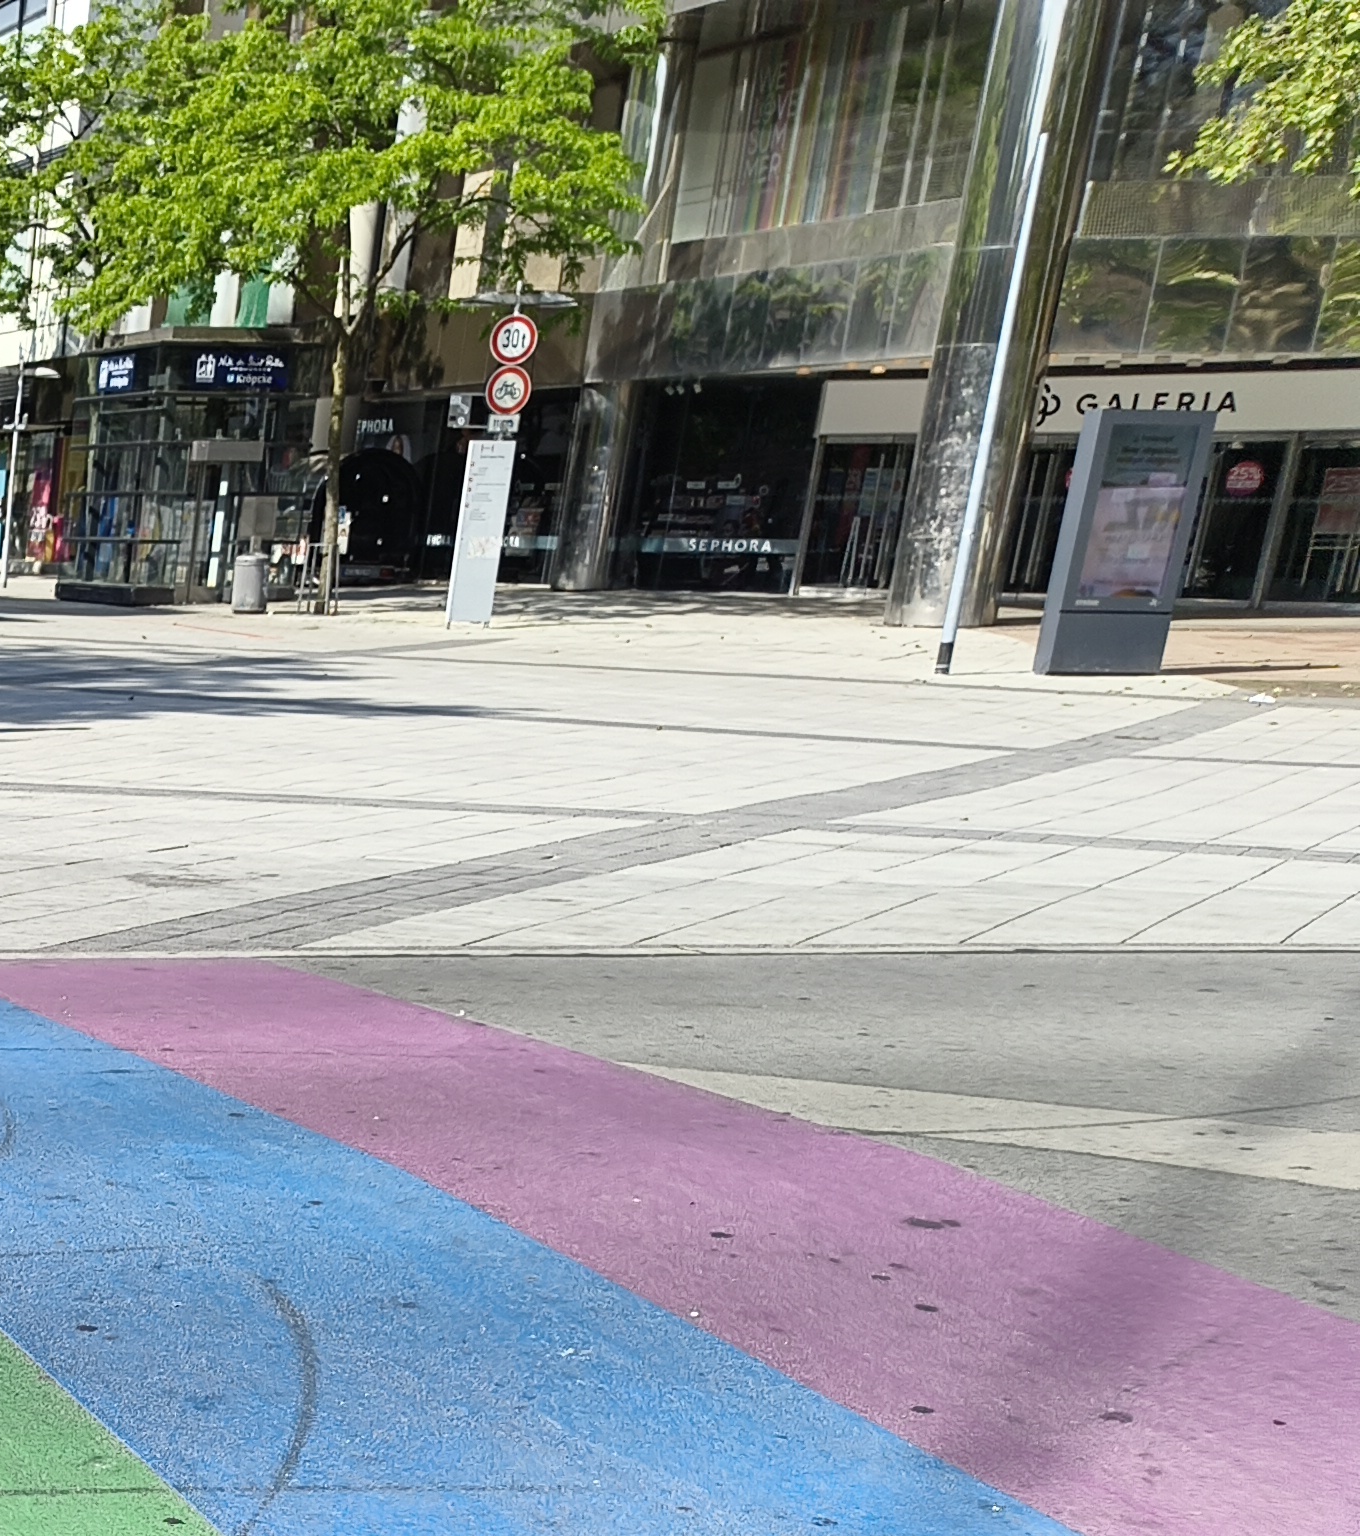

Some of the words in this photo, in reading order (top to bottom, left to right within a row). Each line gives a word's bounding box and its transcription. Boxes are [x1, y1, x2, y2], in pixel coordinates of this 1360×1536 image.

[1076, 391, 1237, 415] GALERIA
[357, 418, 394, 434] EPHORA
[688, 538, 772, 552] SEPHORA
